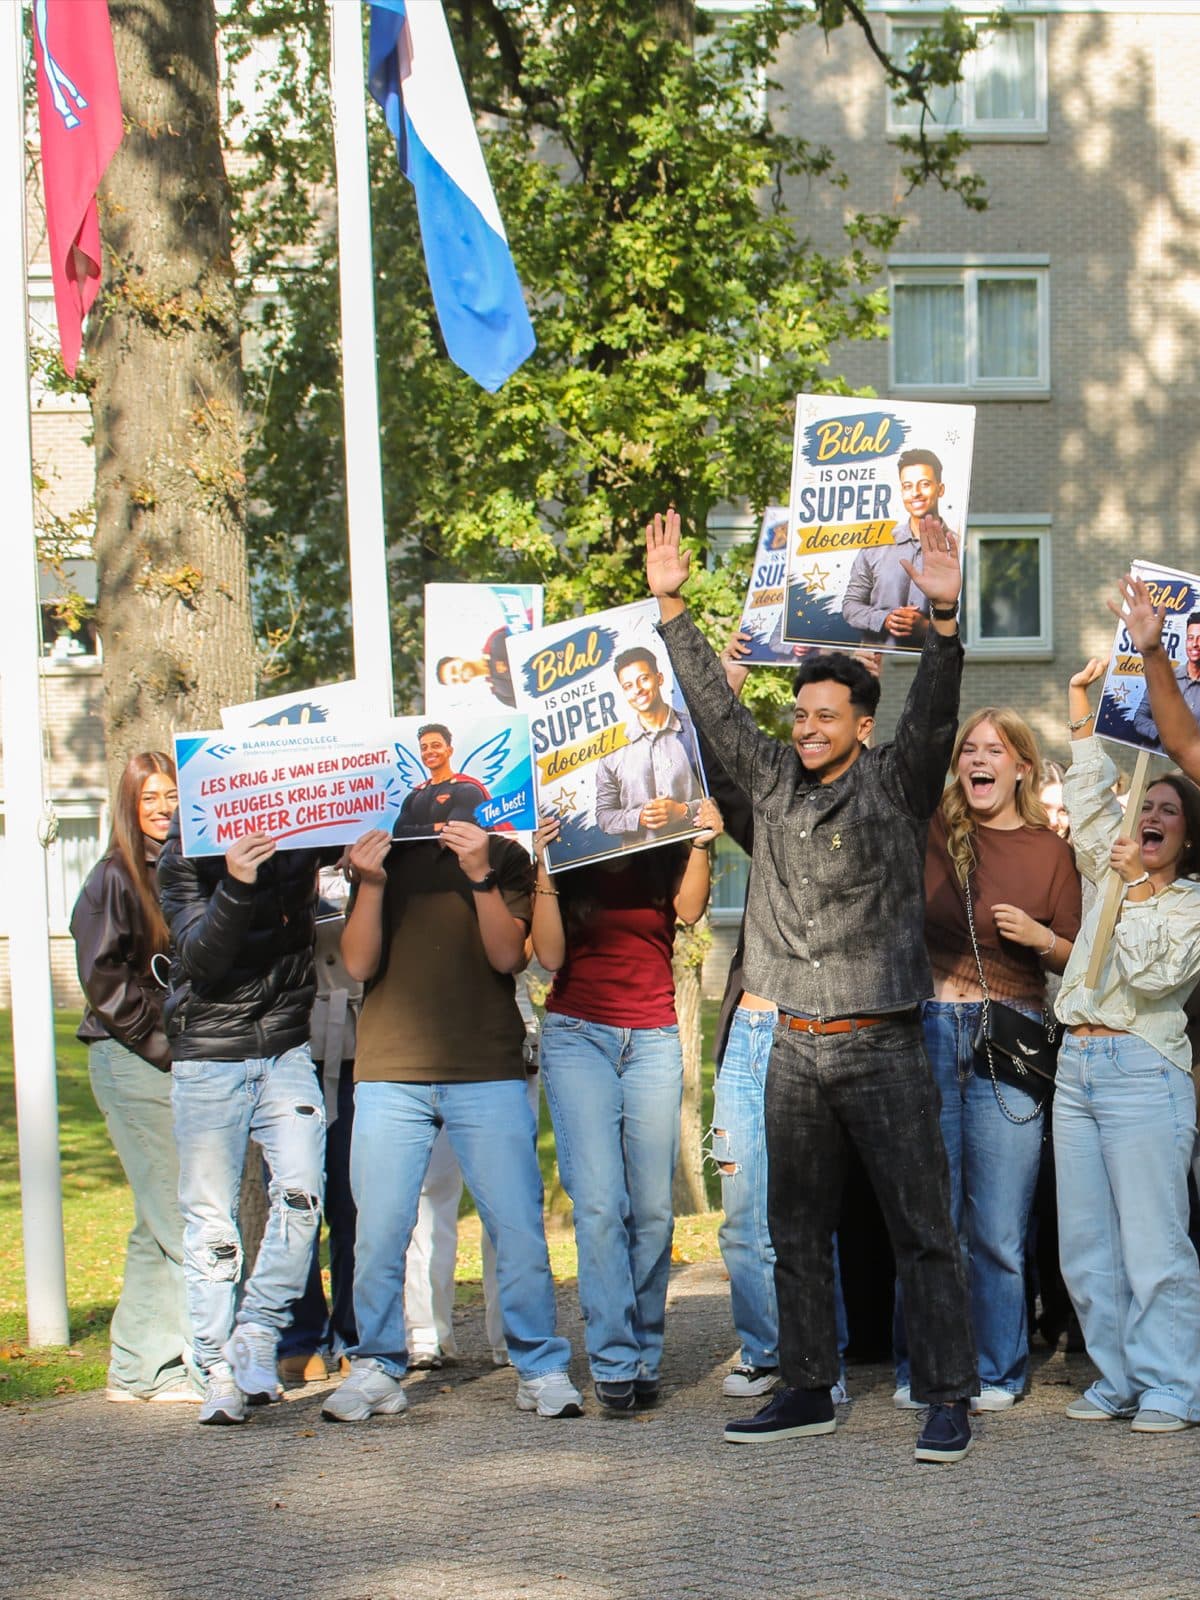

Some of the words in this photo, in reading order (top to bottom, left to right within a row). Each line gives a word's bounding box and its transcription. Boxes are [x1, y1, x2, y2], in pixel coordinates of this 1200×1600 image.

[816, 418, 891, 461] Bilal
[820, 470, 833, 482] IS
[837, 468, 876, 481] ONZE
[800, 484, 892, 524] SUPER
[531, 631, 602, 692] Bilal
[544, 697, 557, 711] IS
[561, 681, 597, 707] ONZE
[242, 735, 338, 749] BLARIACUMCOLLEGE
[532, 691, 619, 753] SUPER
[201, 778, 227, 797] LES
[229, 770, 268, 790] KRIJG
[272, 768, 286, 782] JE
[288, 763, 314, 779] VAN
[317, 758, 339, 774] EEN
[342, 750, 391, 769] DOCENT,
[214, 792, 284, 819] VLEUGELS
[288, 786, 327, 807] KRIJG
[331, 781, 345, 796] JE
[349, 776, 374, 792] VAN
[216, 810, 292, 843] MENEER
[296, 791, 386, 825] CHETOUANI!
[481, 802, 500, 822] The
[502, 791, 526, 813] best!
